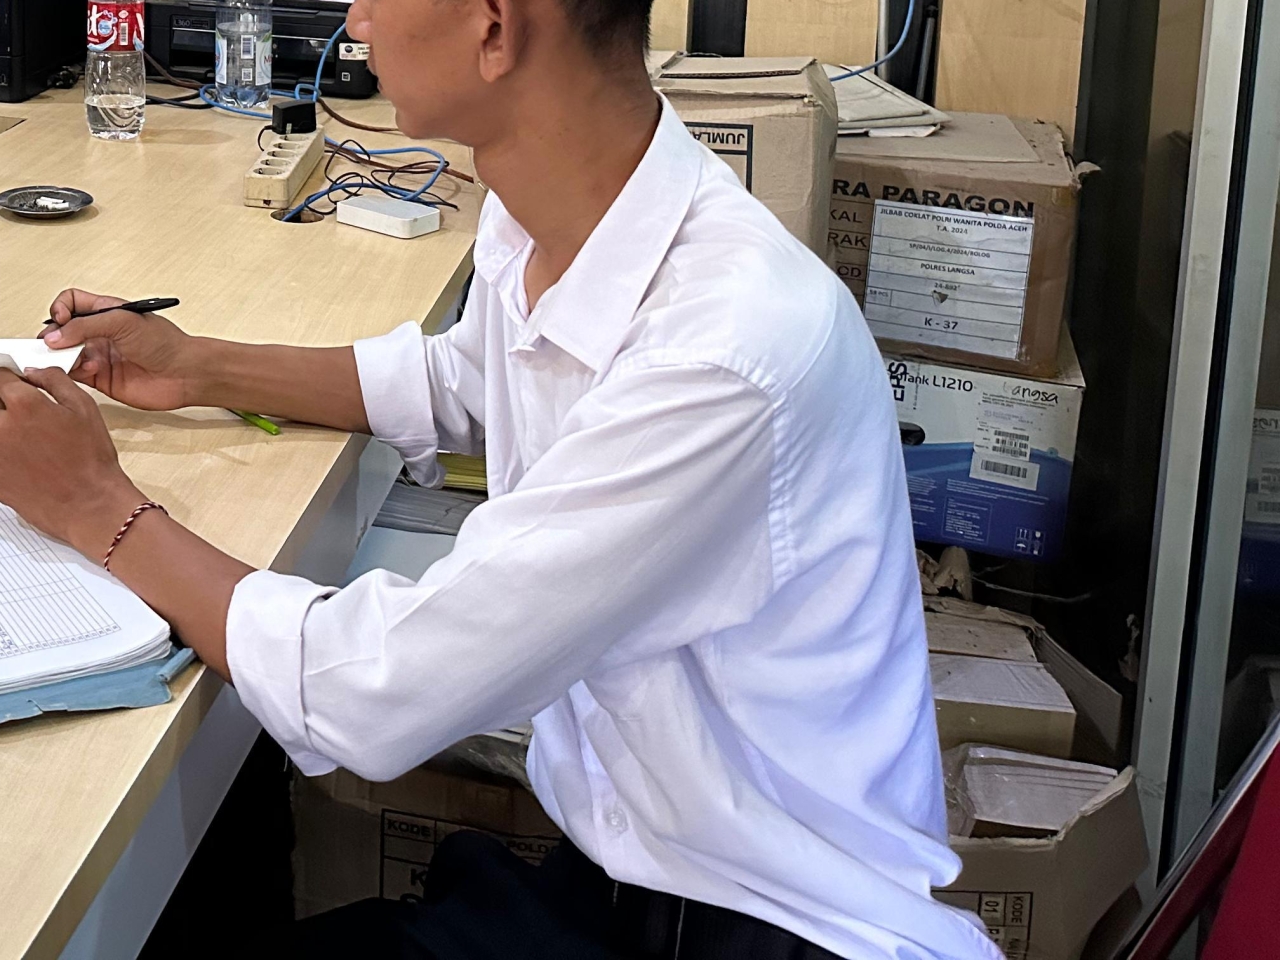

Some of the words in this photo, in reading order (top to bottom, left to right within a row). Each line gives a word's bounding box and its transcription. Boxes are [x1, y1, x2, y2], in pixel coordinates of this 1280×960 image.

[690, 130, 746, 144] JUMLA
[832, 179, 870, 199] RA
[882, 185, 1034, 218] PARAGON
[880, 208, 903, 217] JILBAB
[904, 211, 930, 221] COKLAT
[931, 214, 952, 224] POLRI
[953, 217, 982, 228] WANITA
[983, 221, 1007, 230] POLDA
[1008, 224, 1028, 232] ACEH
[936, 225, 949, 233] T.A.
[951, 226, 968, 235] 2024
[920, 263, 946, 273] POLRES
[947, 265, 975, 276] LANGSA
[924, 317, 933, 327] K
[943, 320, 959, 330] 37
[932, 375, 974, 392] L1210
[387, 819, 431, 838] KODE
[505, 841, 549, 854] POLD
[1011, 896, 1024, 923] KODE
